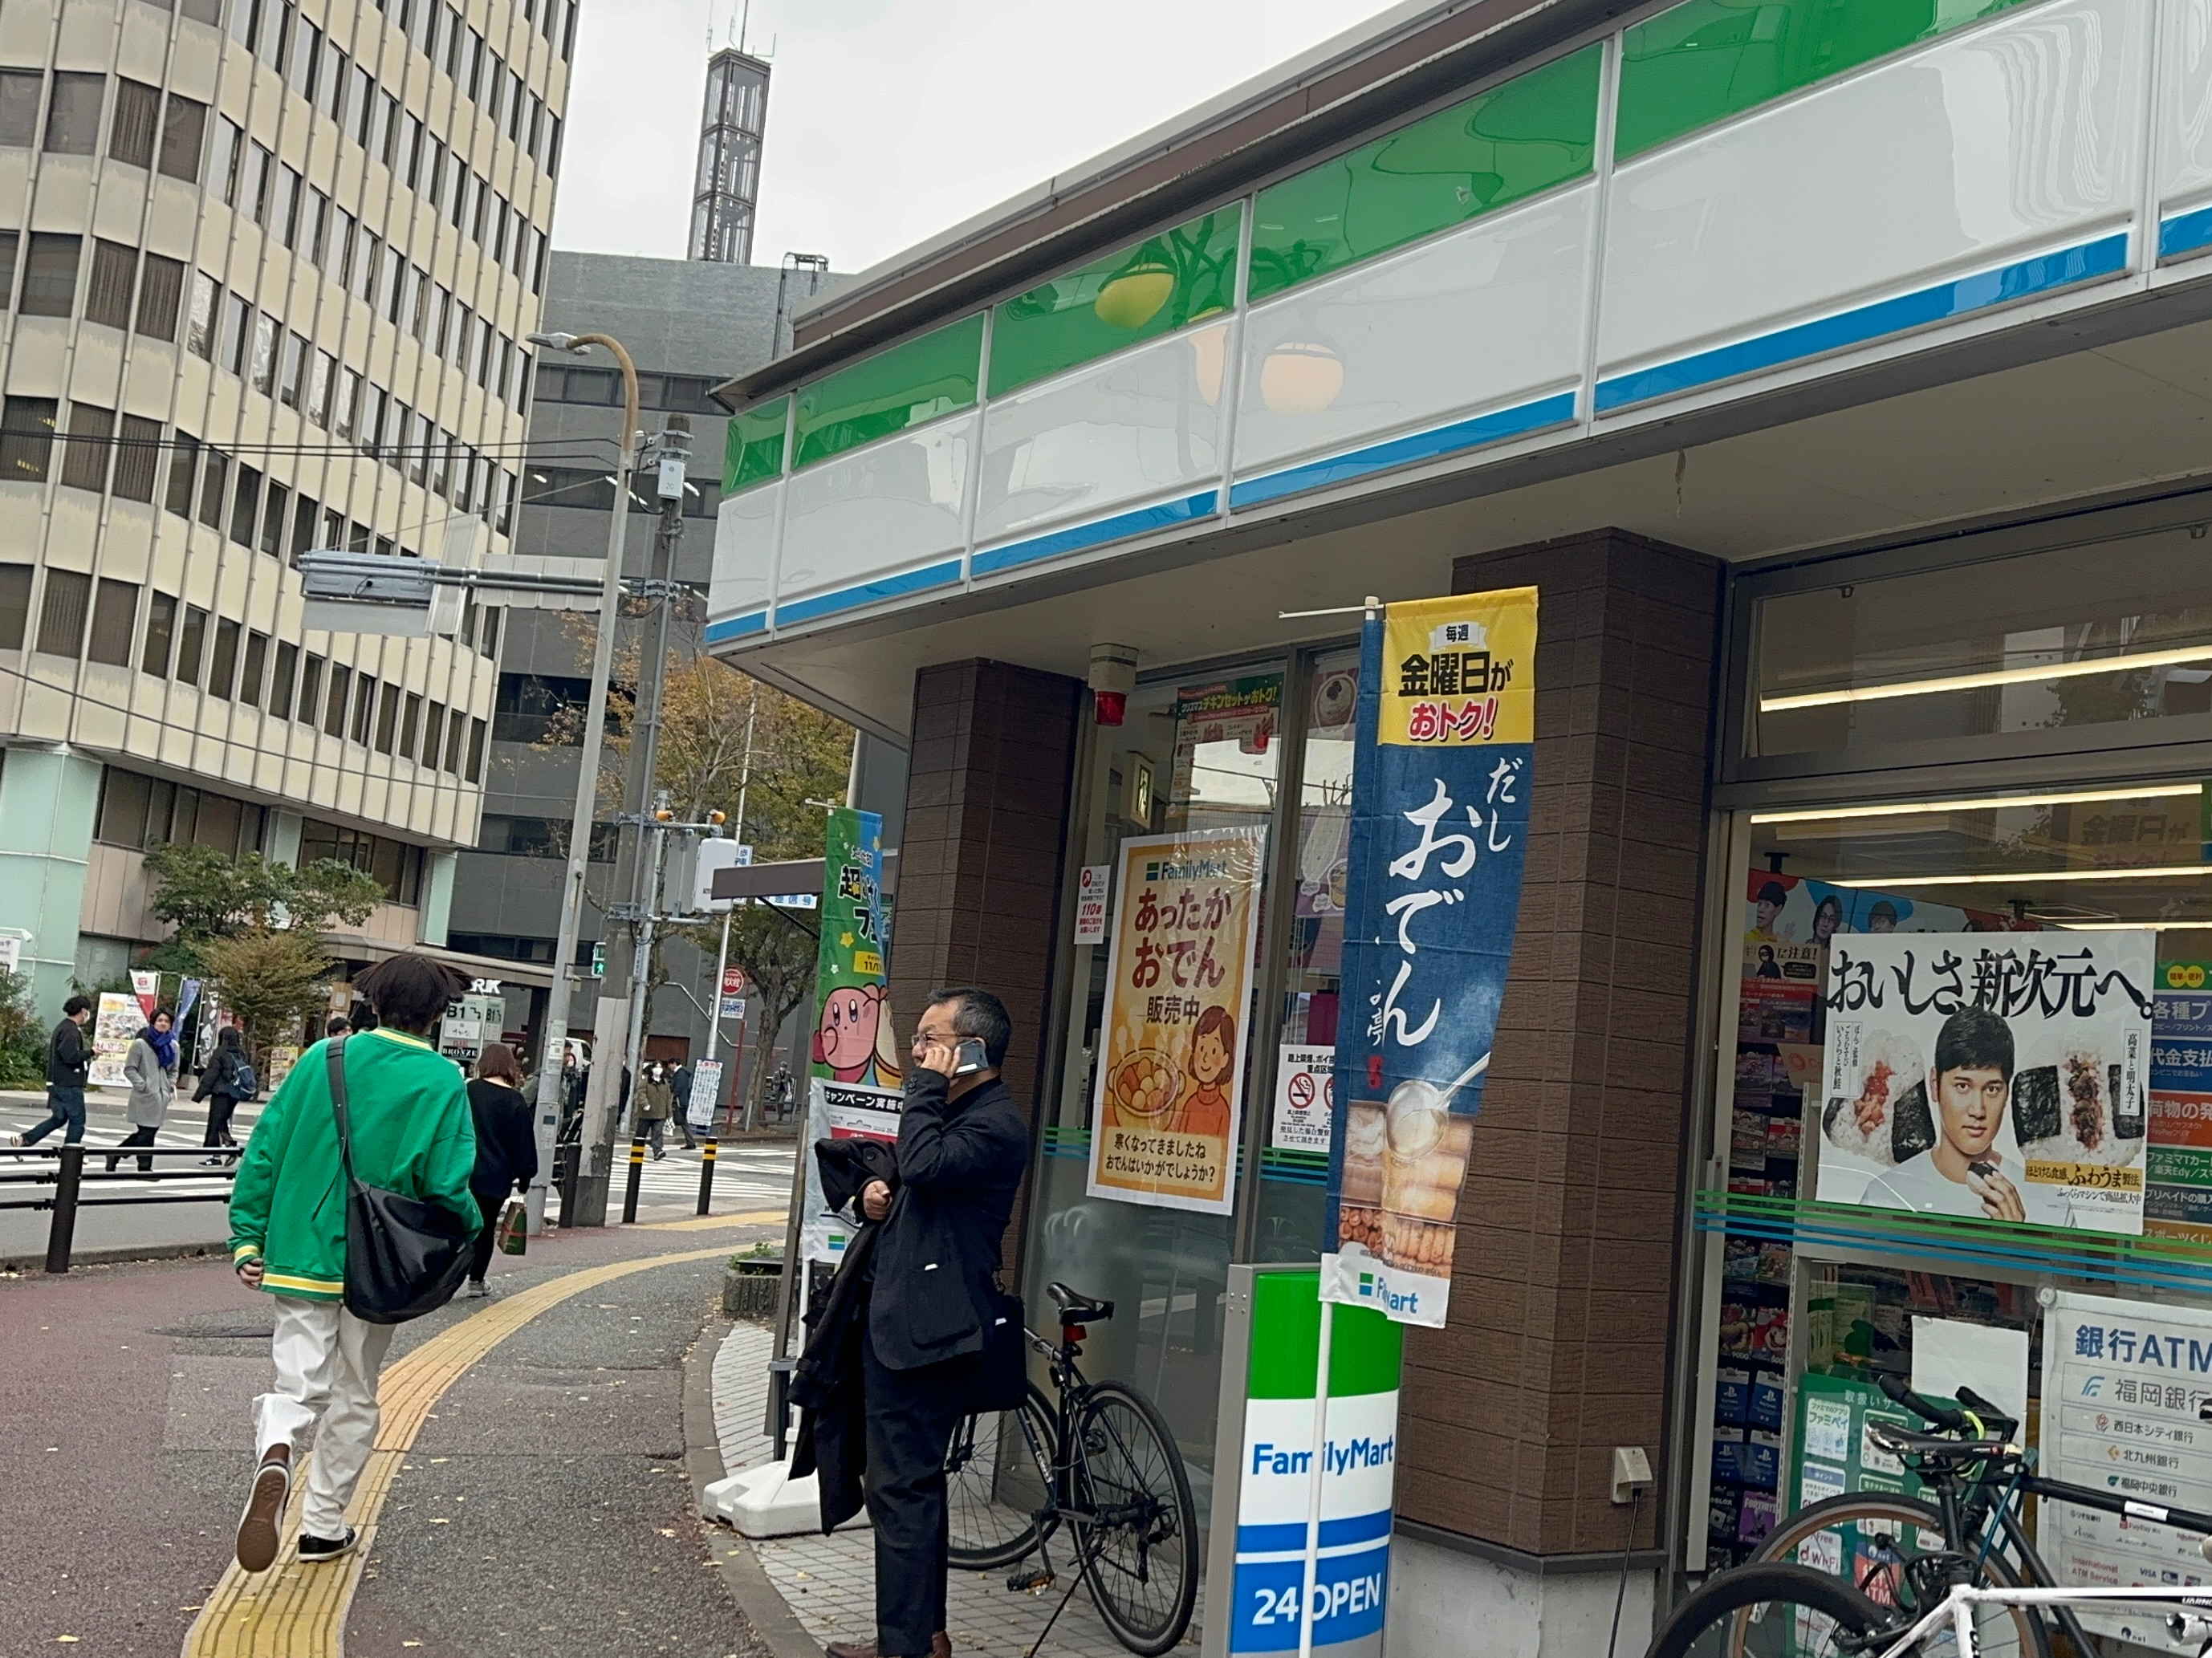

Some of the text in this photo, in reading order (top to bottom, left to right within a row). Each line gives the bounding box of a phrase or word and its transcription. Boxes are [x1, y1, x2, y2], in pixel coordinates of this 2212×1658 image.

[1446, 624, 1470, 643] 毎週
[1397, 651, 1514, 697] 金曜日が
[1408, 697, 1498, 742] おトク!
[1486, 757, 1524, 852] だし
[1161, 859, 1228, 881] FamilyMart
[1134, 887, 1232, 933] あったか
[1382, 778, 1482, 1049] おでん
[1132, 936, 1226, 990] おでん
[1825, 947, 2154, 1020] おいしさ新次元へ。
[446, 1006, 465, 1018] B1
[1145, 995, 1200, 1026] 販売中
[2153, 1000, 2212, 1021] 各種プ
[442, 1047, 477, 1057] BRONZE
[2150, 1046, 2212, 1067] 代金支払
[2125, 1033, 2138, 1110] 高菜と明太子
[2148, 1099, 2212, 1121] 荷物の発
[1114, 1133, 1206, 1159] 寒くなってきましたね
[1106, 1154, 1215, 1182] おでんはいかがでしょうか?
[2147, 1152, 2212, 1167] ファミマTカー
[2076, 1324, 2212, 1373] 銀行ATM
[1844, 1389, 1905, 1412] 取扱いサー
[2115, 1379, 2210, 1413] 福岡銀行
[1808, 1412, 1848, 1429] ファミペイ
[2114, 1420, 2194, 1444] 西日本シティ銀行
[2123, 1449, 2179, 1469] 北九州銀行
[2121, 1477, 2177, 1498] 福岡中央銀行
[1816, 1533, 1833, 1545] Free
[2072, 1555, 2118, 1573] International
[2140, 1567, 2157, 1579] VISA
[2072, 1567, 2118, 1586] ATM Service
[1252, 1573, 1381, 1626] 24 OPEN
